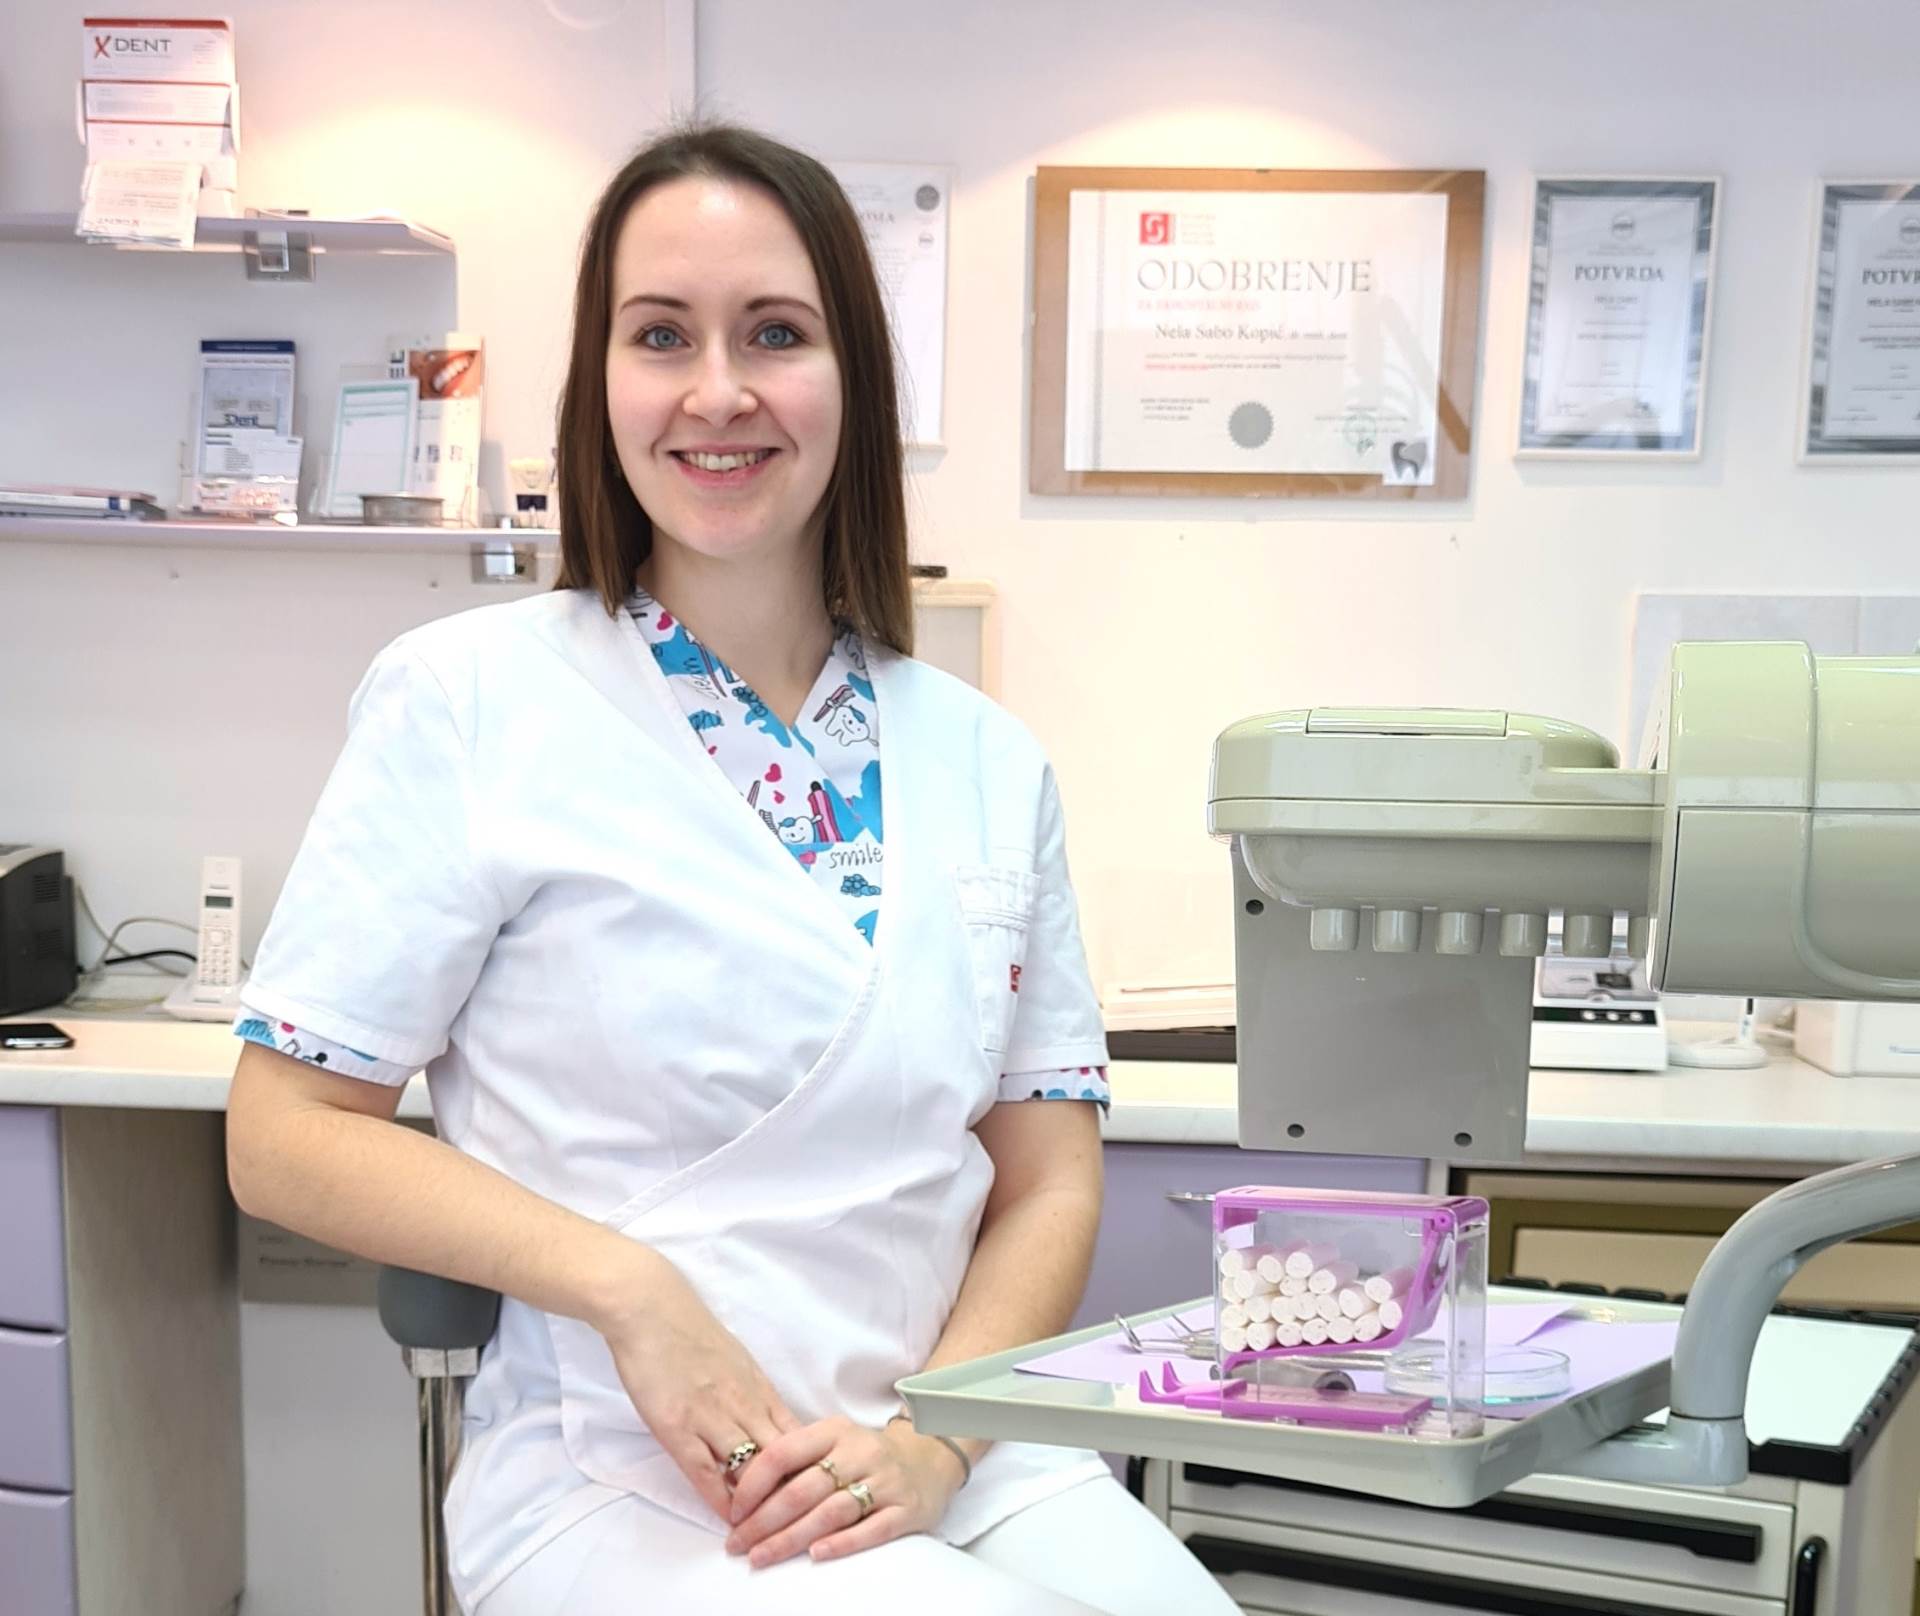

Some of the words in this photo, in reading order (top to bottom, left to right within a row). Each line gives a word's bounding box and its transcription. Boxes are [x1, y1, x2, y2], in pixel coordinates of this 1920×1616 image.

[114, 37, 172, 52] DENT
[1137, 259, 1371, 300] ODOBRENJE
[1574, 264, 1664, 282] POTVRDA
[1155, 324, 1191, 341] Nela
[1195, 324, 1234, 341] Sabo
[829, 842, 884, 869] smile
